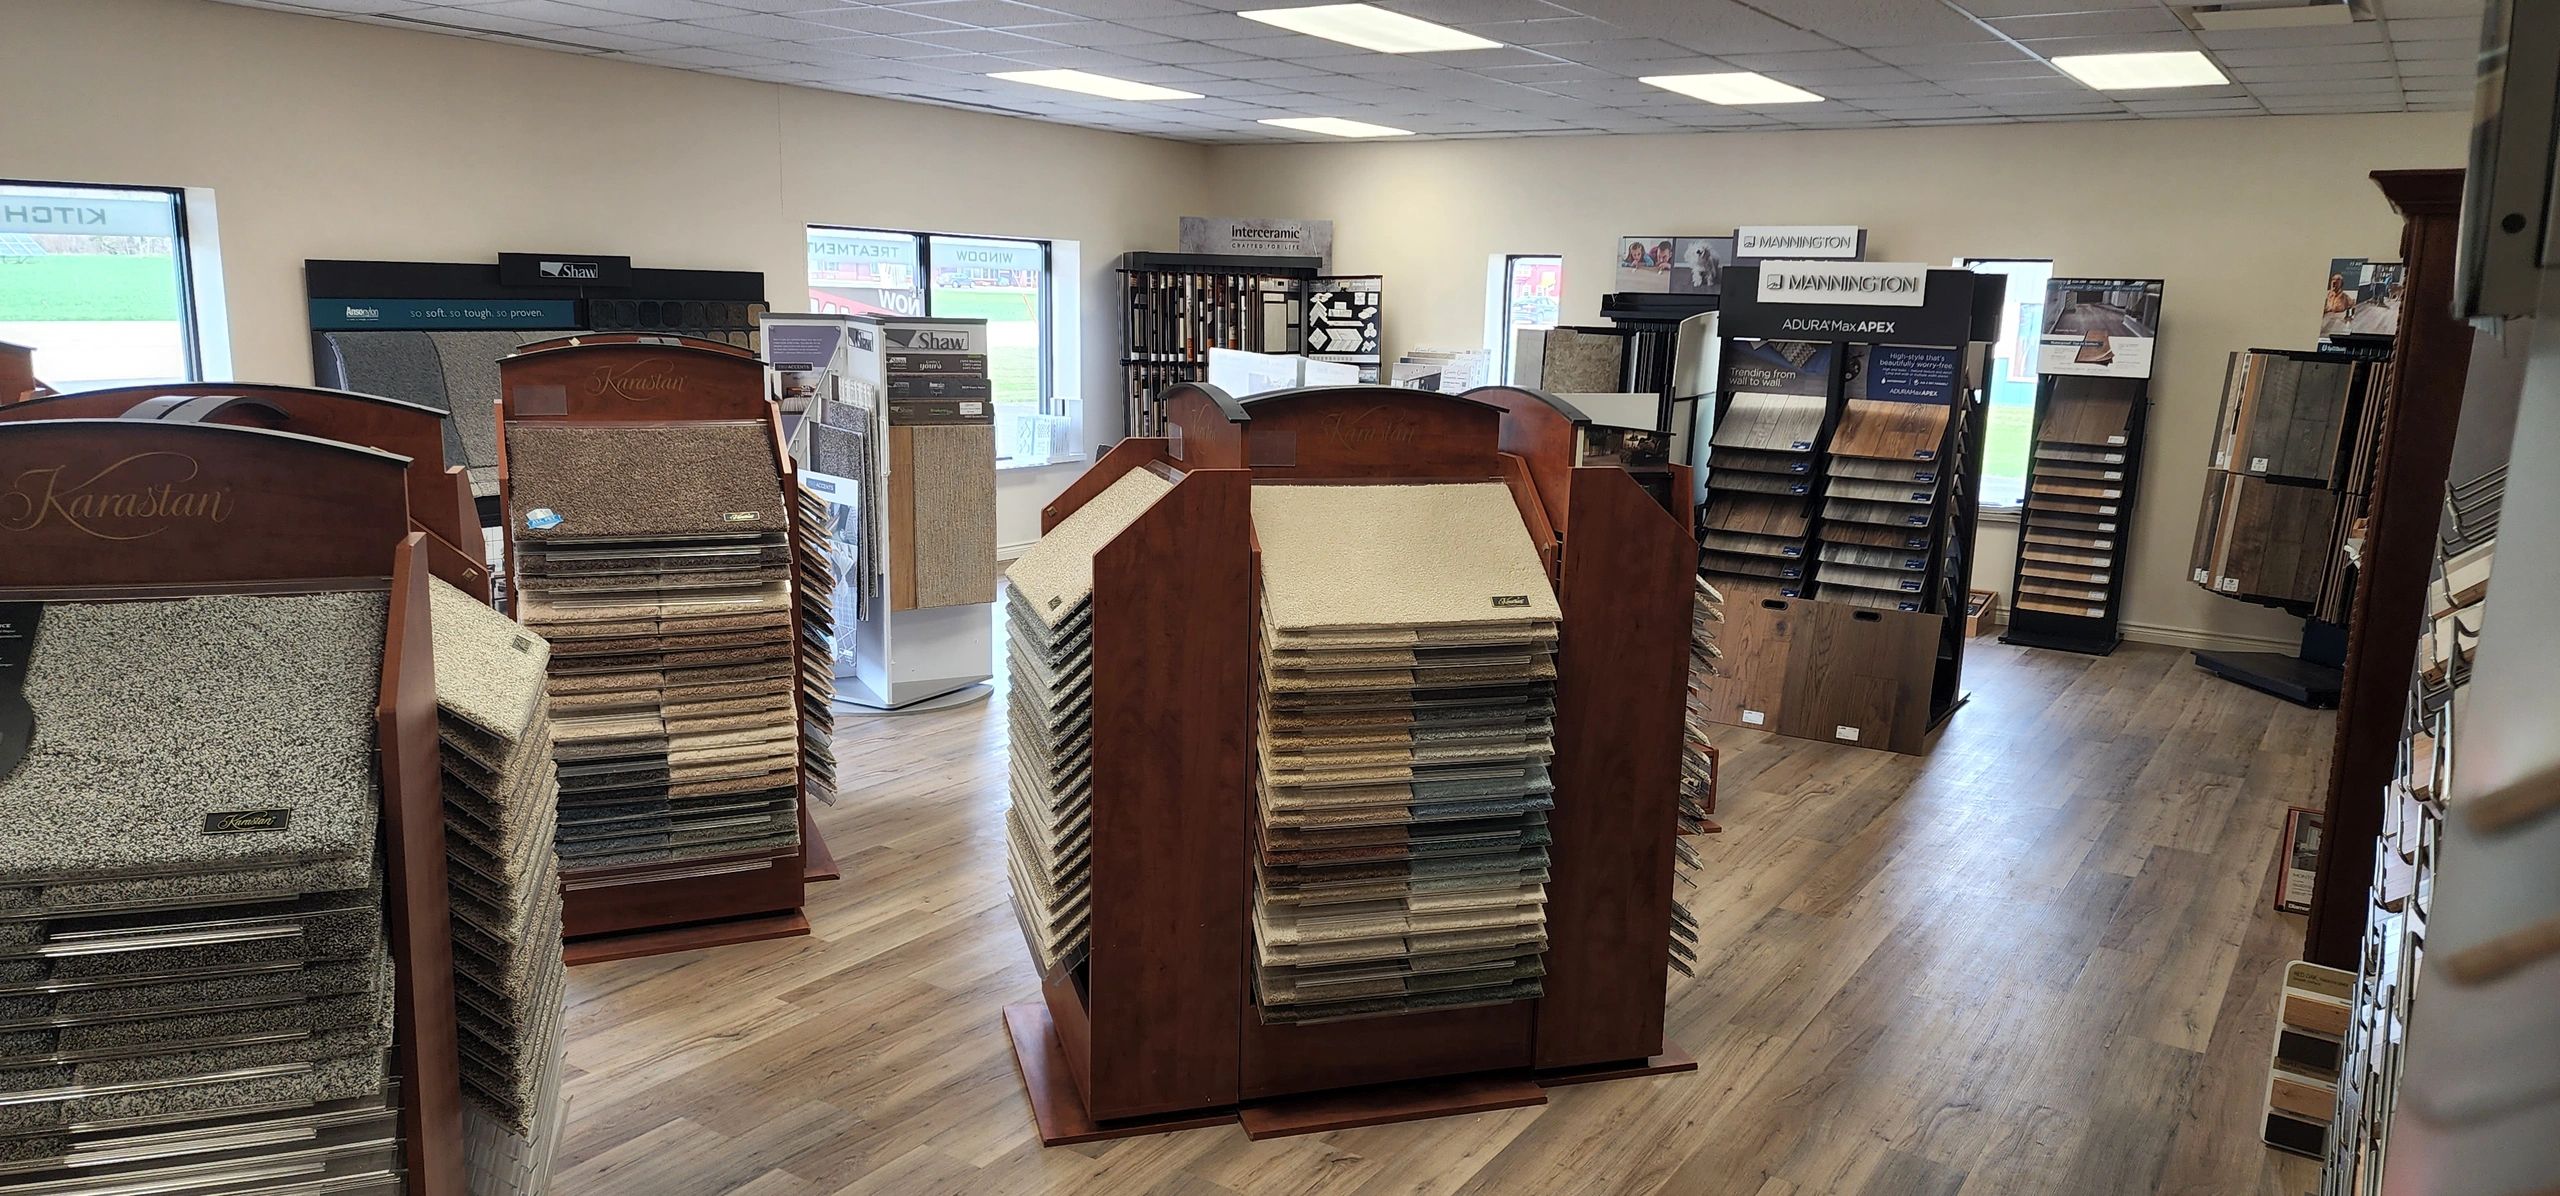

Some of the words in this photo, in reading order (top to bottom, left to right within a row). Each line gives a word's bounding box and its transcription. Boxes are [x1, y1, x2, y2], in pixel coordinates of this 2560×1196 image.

[1231, 224, 1300, 239] Interceramic
[1759, 235, 1851, 249] MANNINGTON
[562, 264, 597, 279] Shaw
[1788, 274, 1918, 293] MANNINGTON
[410, 309, 423, 318] so
[425, 307, 448, 319] soft.
[449, 309, 461, 318] so
[464, 308, 495, 320] tough.
[496, 309, 508, 318] so
[510, 309, 545, 320] proven.
[918, 331, 965, 351] Shaw
[584, 358, 688, 401] Karastan
[1730, 367, 1771, 379] Trending
[1773, 368, 1796, 380] from
[1729, 377, 1748, 386] wall
[1749, 378, 1760, 386] to
[1762, 379, 1783, 388] wall.
[0, 450, 236, 540] Karastan
